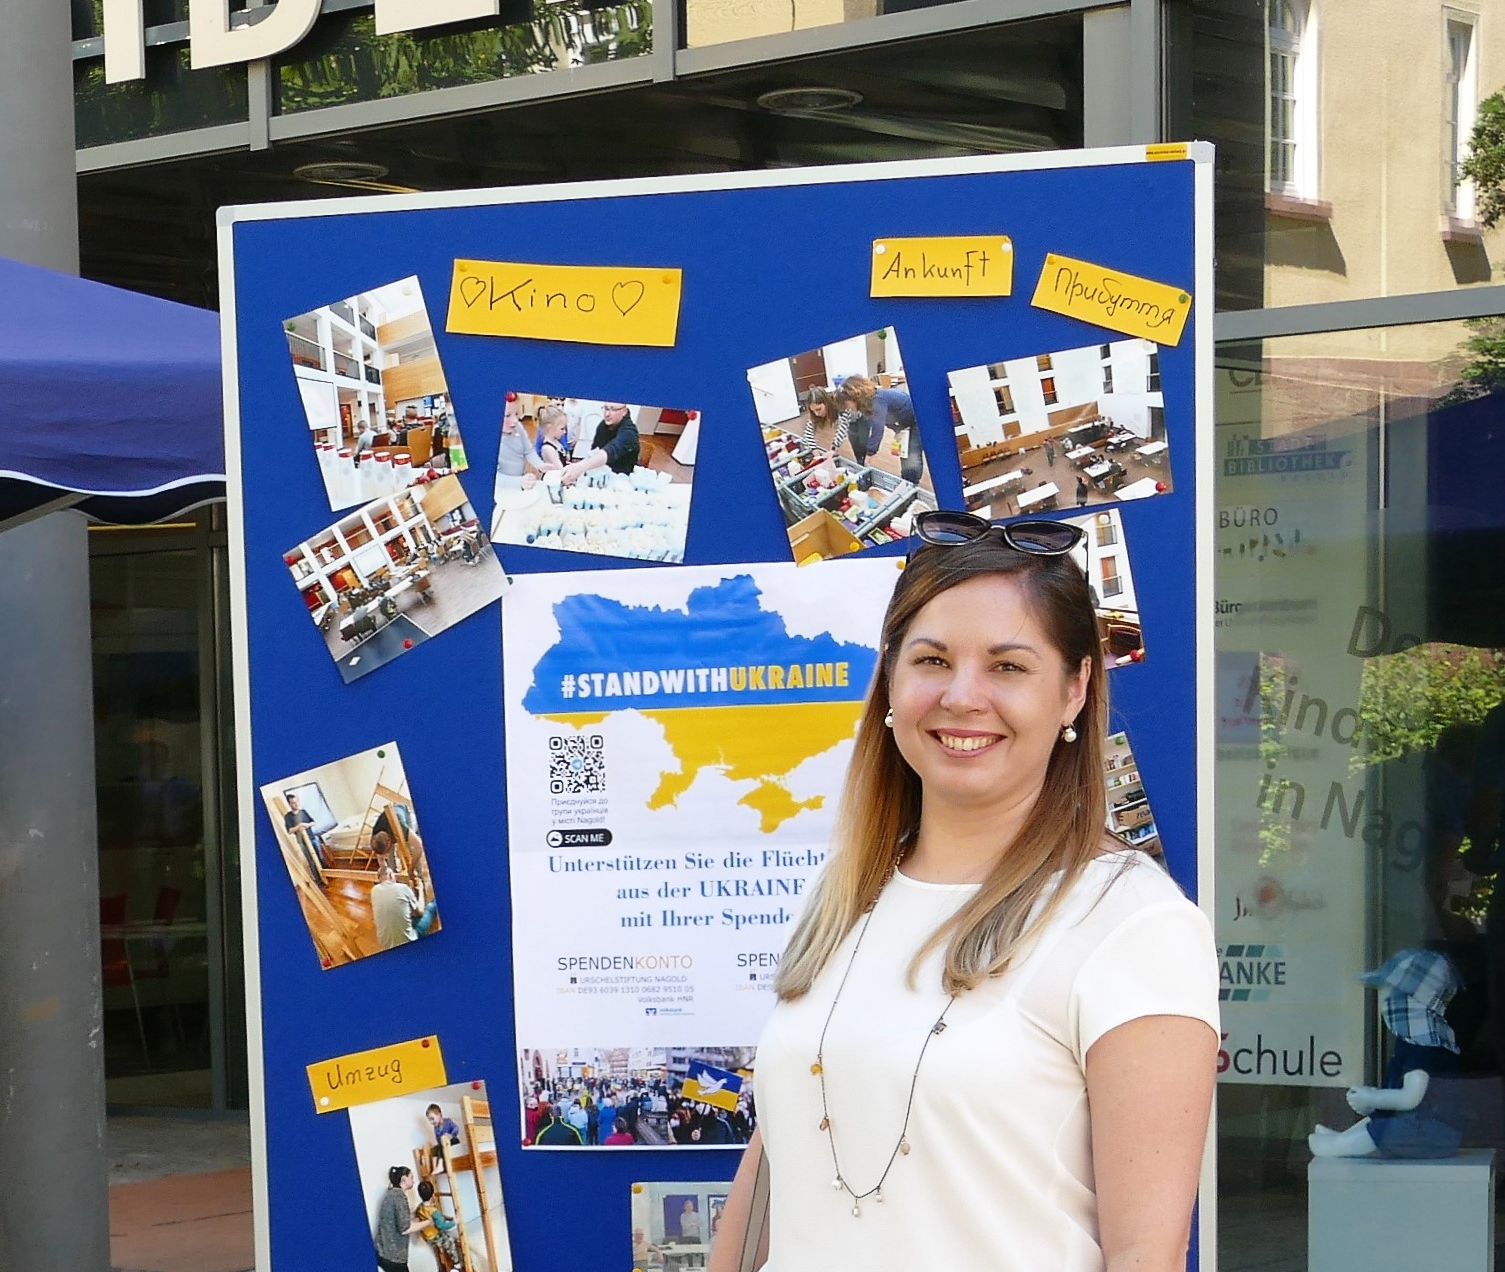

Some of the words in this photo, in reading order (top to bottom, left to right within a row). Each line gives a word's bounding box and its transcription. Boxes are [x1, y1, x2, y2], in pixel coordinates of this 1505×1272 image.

[490, 276, 596, 313] Kino
[1228, 455, 1335, 475] BIBLIOTHEK
[1219, 506, 1279, 529] BÜRO
[560, 661, 850, 699] #STANDWITHUKRAINE
[564, 833, 589, 845] SCAN
[590, 832, 606, 843] ME
[549, 855, 678, 873] Unterstützen
[684, 851, 716, 870] Sie
[723, 850, 754, 869] die
[616, 886, 651, 900] aus
[657, 881, 692, 899] der
[620, 911, 654, 928] mit
[661, 909, 715, 927] Ihrer
[557, 954, 694, 971] SPENDENKONTO
[579, 976, 653, 985] URSCHELSTIFTUNG
[654, 975, 688, 984] NAGOLD
[637, 995, 676, 1004] Volksbank
[326, 1059, 403, 1090] Umzug
